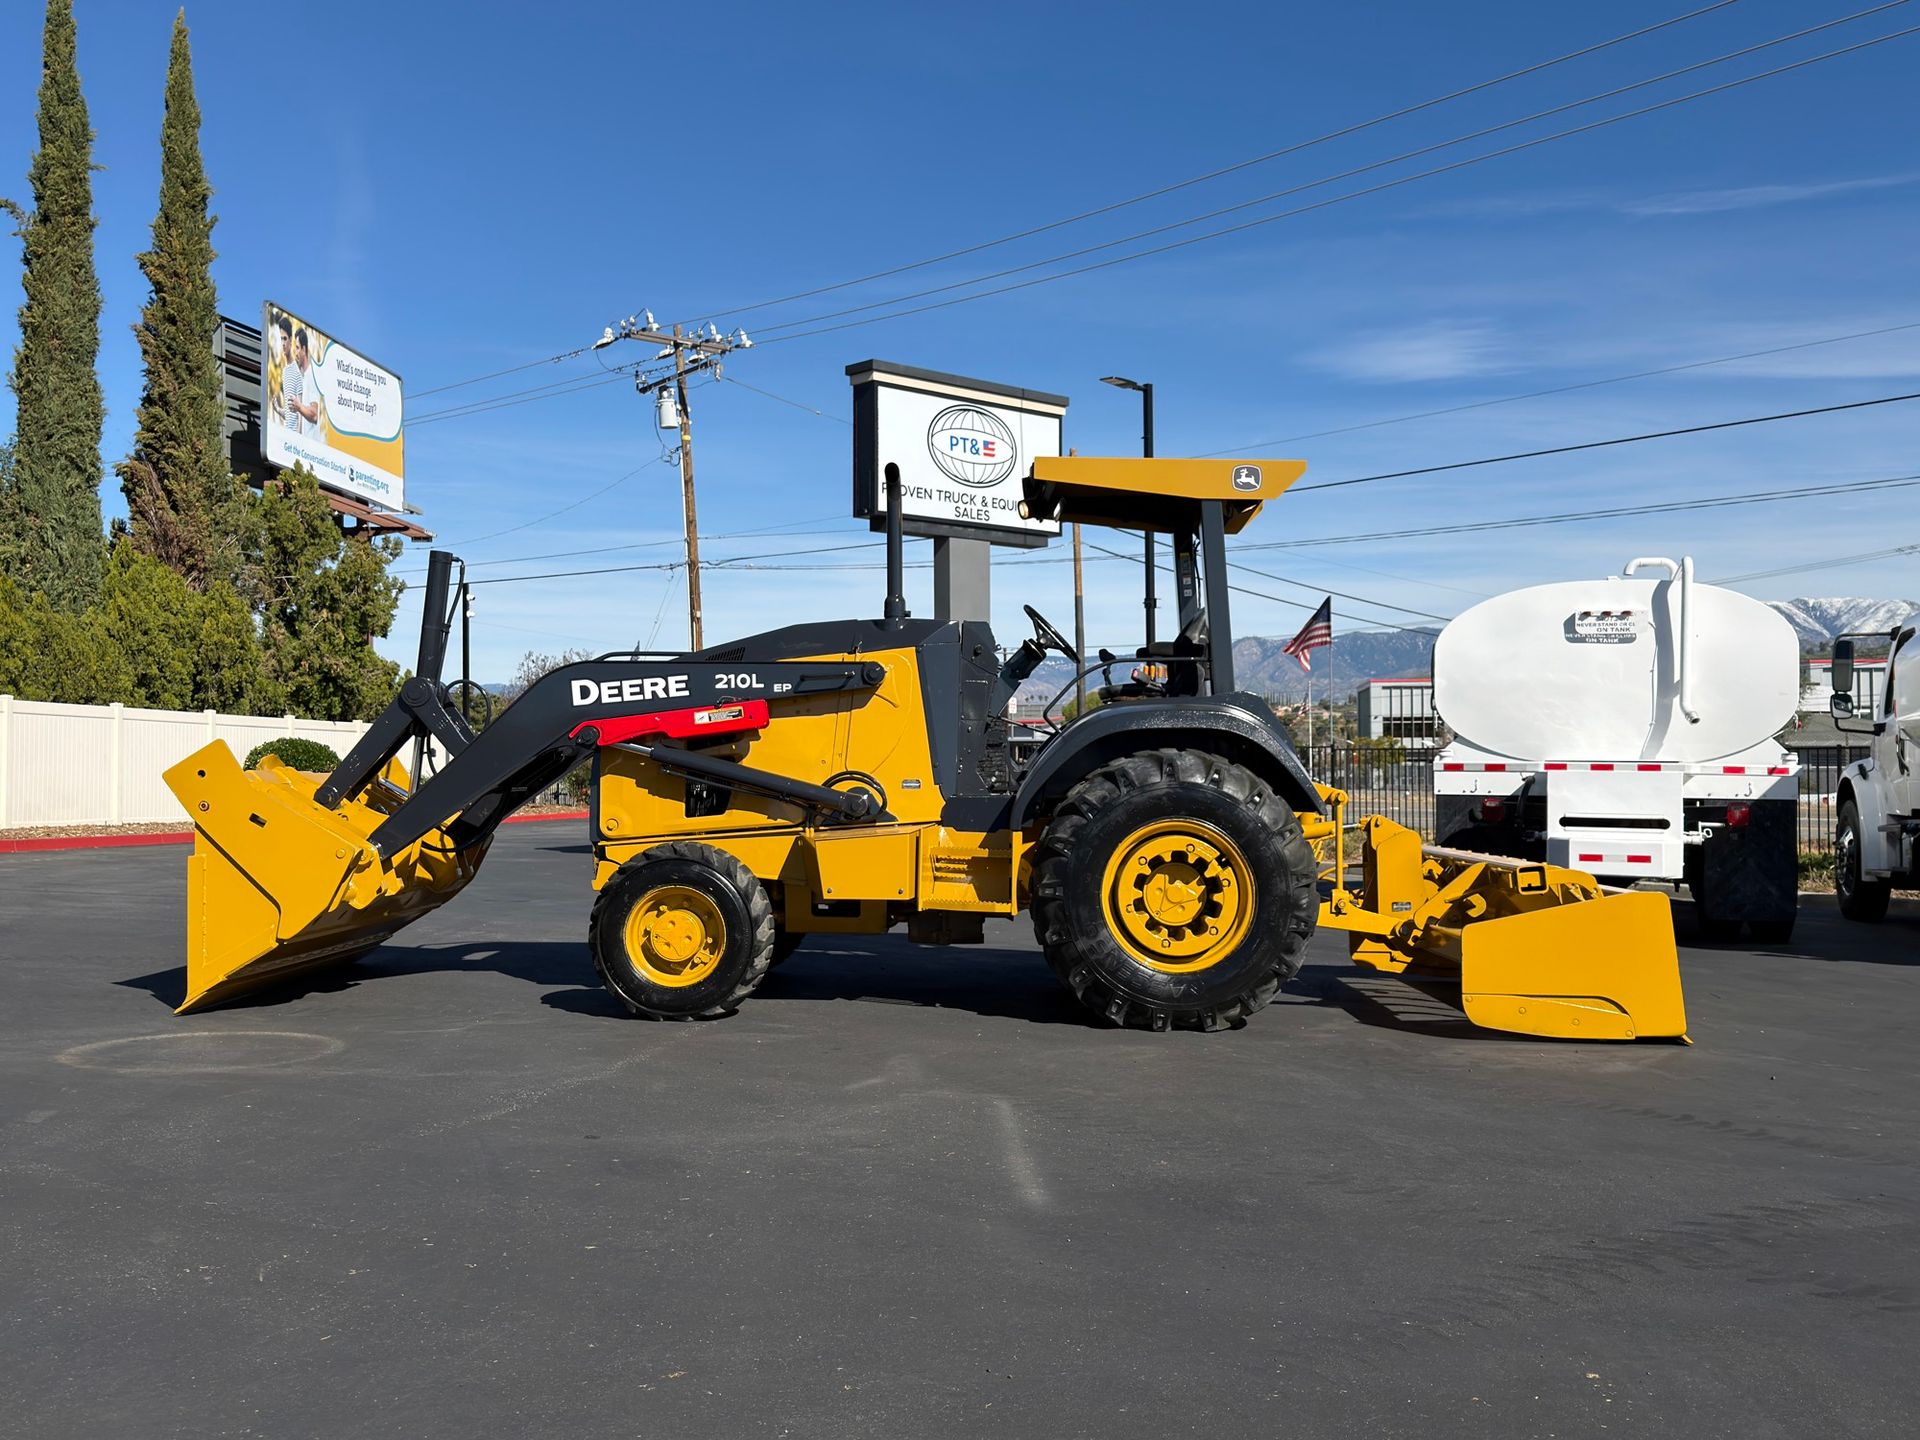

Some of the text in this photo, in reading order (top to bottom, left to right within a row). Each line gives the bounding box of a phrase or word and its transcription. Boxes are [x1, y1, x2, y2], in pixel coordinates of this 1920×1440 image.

[336, 359, 387, 386] What's one thing you
[337, 379, 371, 398] would change
[337, 394, 377, 416] about your day?
[284, 442, 347, 474] Get the Conversation Started
[949, 435, 996, 458] PT&E
[355, 471, 390, 494] parenting.org
[881, 482, 1018, 511] POVEN TRUCK & EQUI
[954, 506, 990, 521] SALES
[571, 675, 690, 706] DEERE
[714, 673, 793, 692] 210L EP
